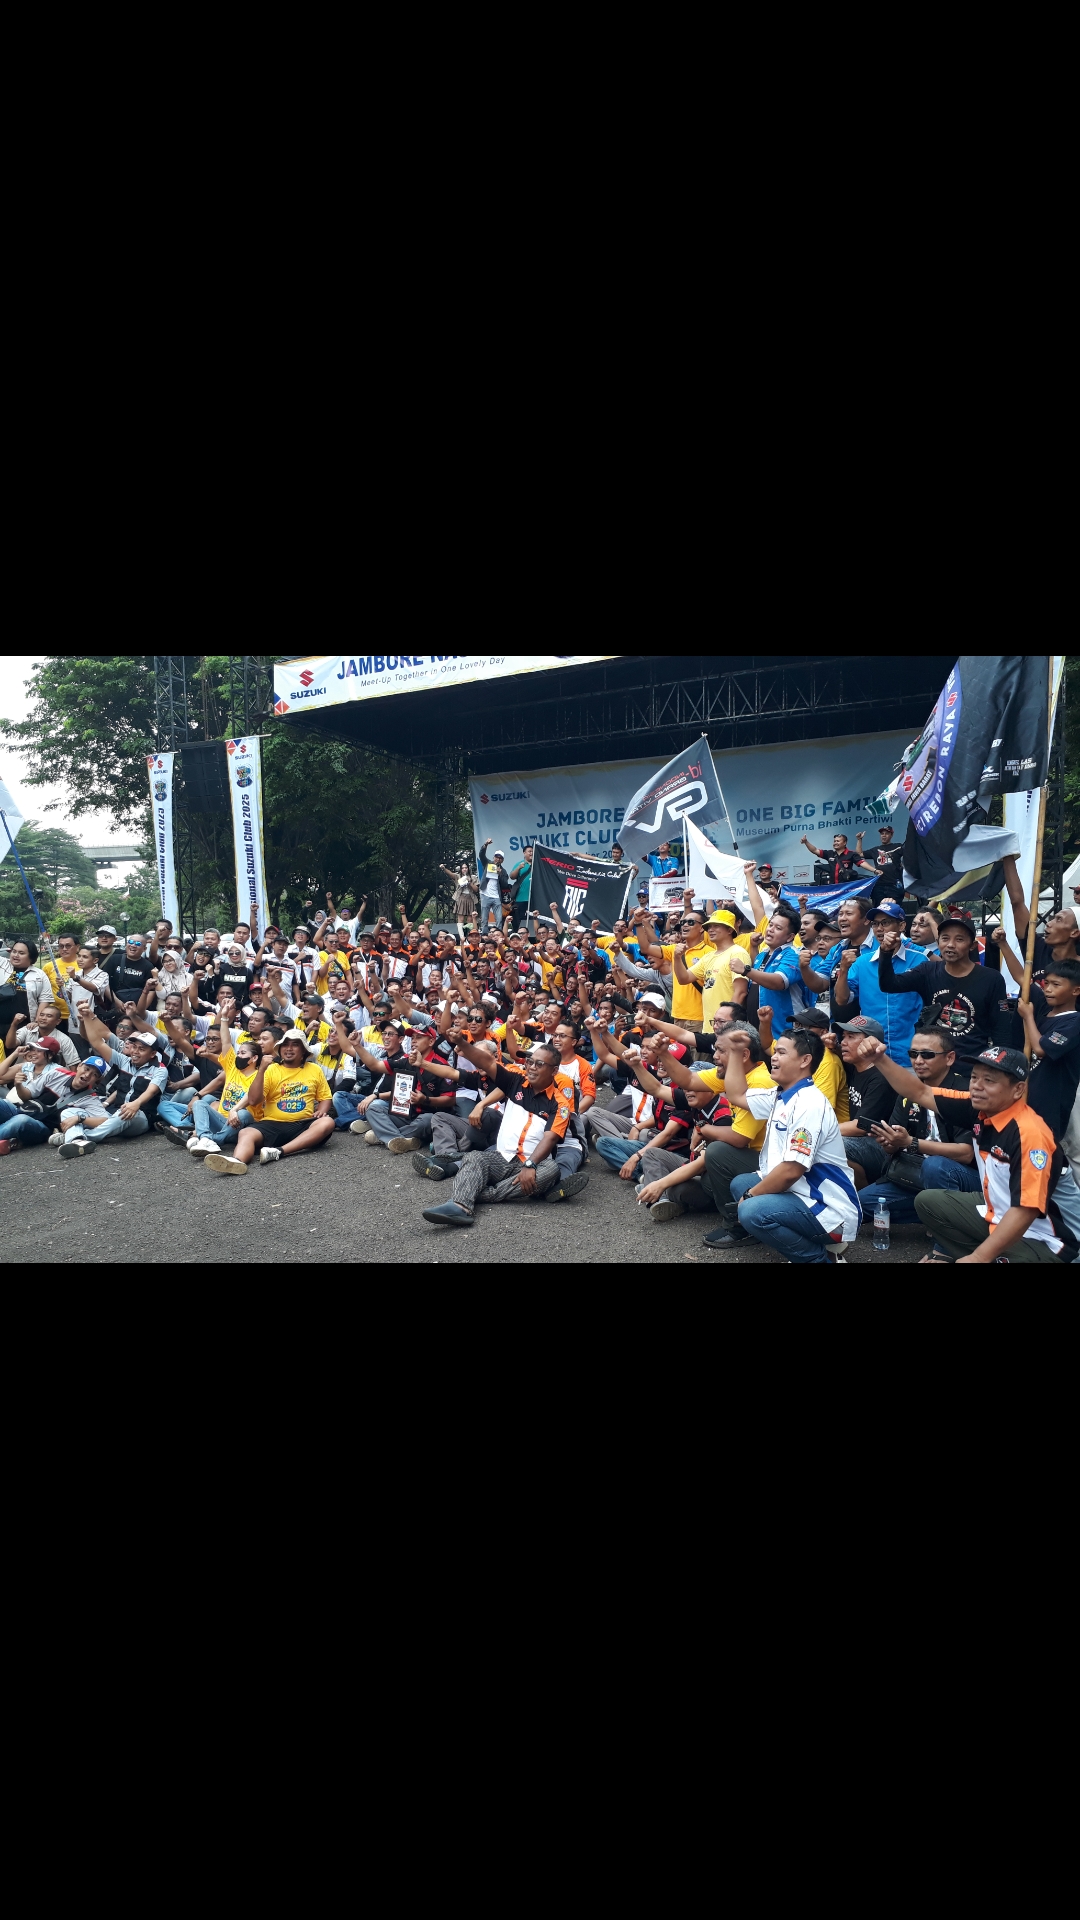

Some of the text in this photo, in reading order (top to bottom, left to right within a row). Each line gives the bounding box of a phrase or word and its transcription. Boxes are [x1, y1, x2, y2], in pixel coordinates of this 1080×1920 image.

[361, 676, 391, 687] Meet-Up
[395, 670, 428, 682] Together
[430, 667, 438, 675] in
[440, 665, 457, 674] One
[460, 659, 486, 670] Lovely
[489, 657, 505, 665] Day
[290, 687, 326, 700] SUZUKI
[940, 708, 956, 756] RAYA
[242, 794, 251, 818] 2025
[491, 791, 530, 802] SUZUKI
[536, 807, 625, 829] JAMBORE
[736, 796, 878, 823] ONE BIG FAMI
[243, 820, 253, 842] Club
[736, 814, 893, 836] Museum Purna Bhakti Pertiwi
[509, 832, 570, 851] SUZUKI
[244, 844, 255, 875] Suzuki
[281, 1101, 302, 1110] 2025
